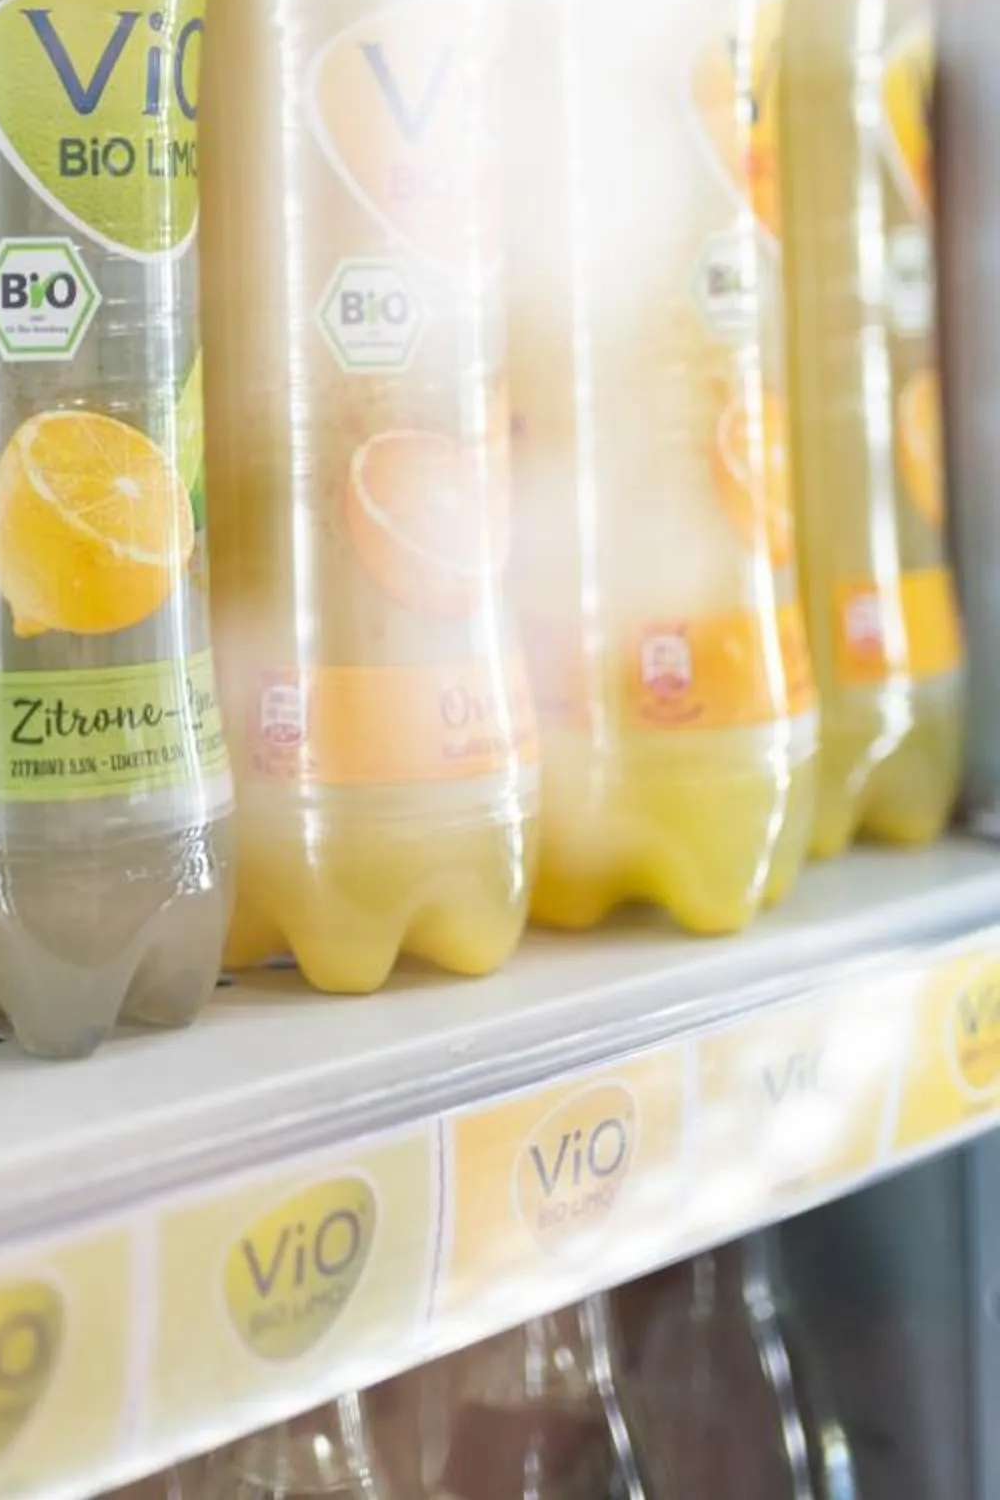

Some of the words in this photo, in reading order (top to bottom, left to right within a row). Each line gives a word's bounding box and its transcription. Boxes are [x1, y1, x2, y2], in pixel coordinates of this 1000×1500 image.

[60, 137, 135, 177] BiO
[2, 272, 77, 309] BiO
[341, 290, 408, 325] BiO
[529, 1117, 626, 1197] ViO
[242, 1209, 361, 1299] ViO
